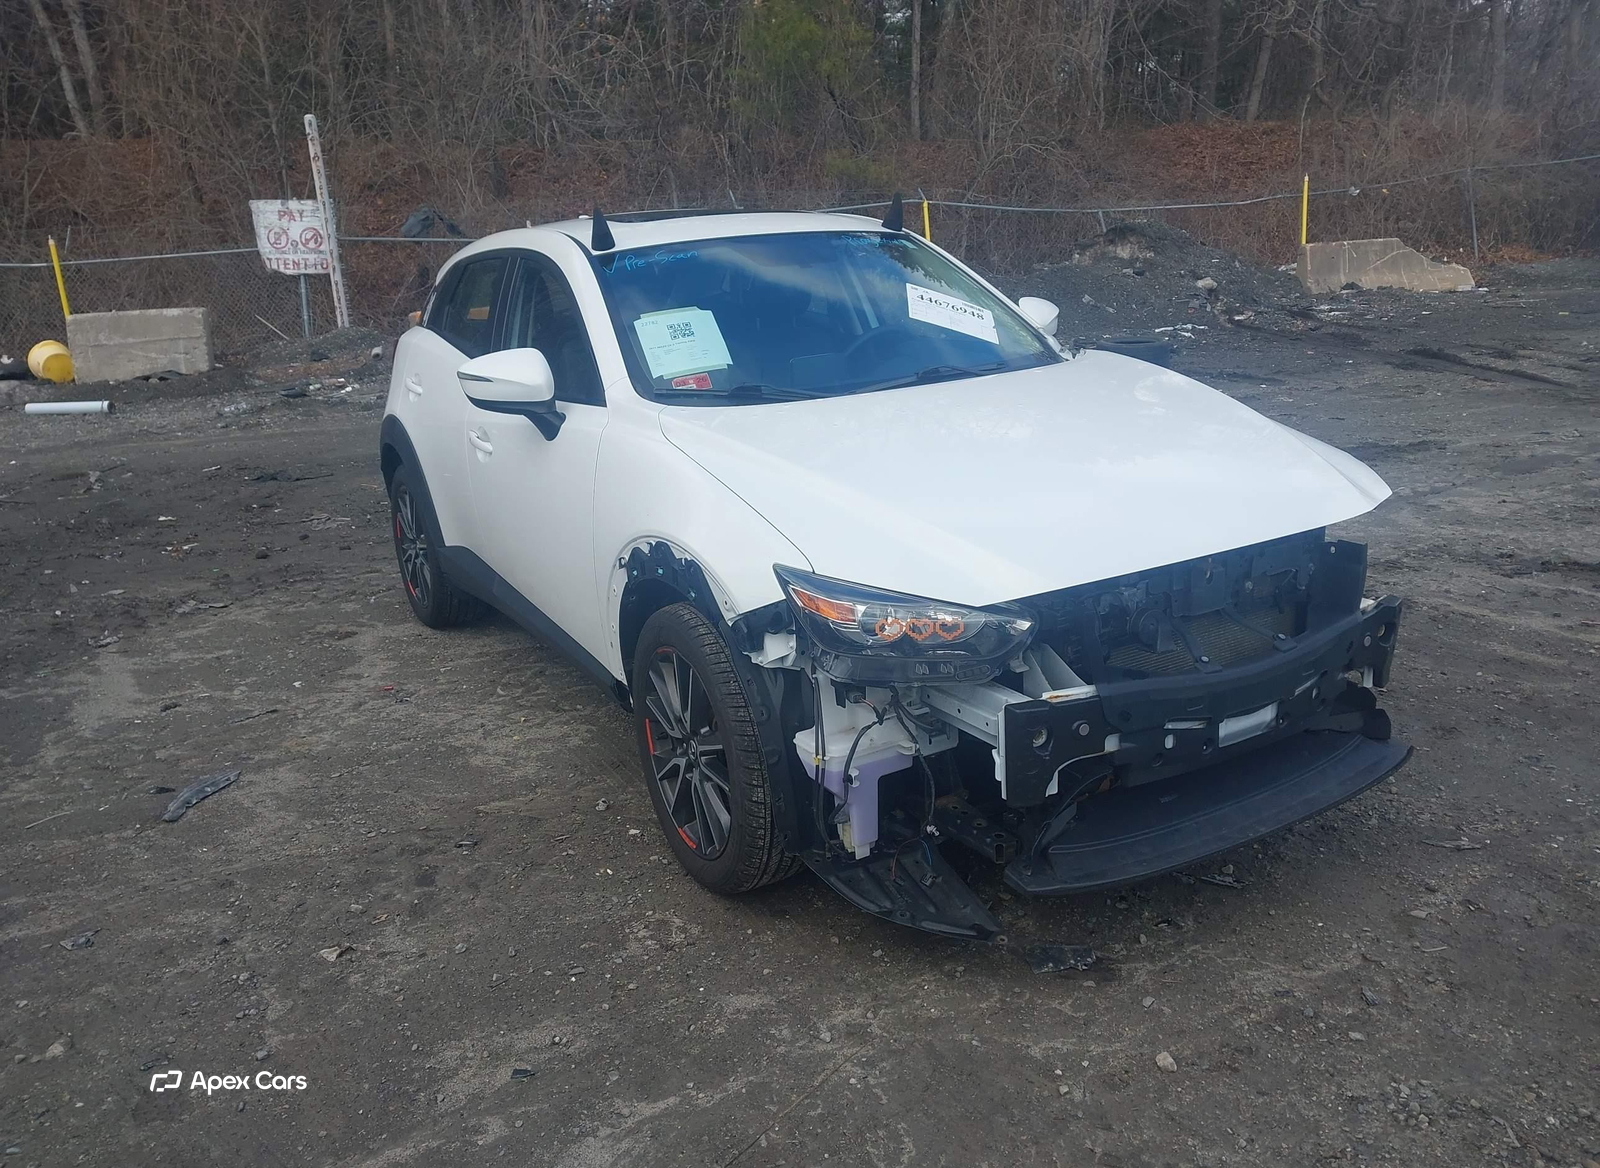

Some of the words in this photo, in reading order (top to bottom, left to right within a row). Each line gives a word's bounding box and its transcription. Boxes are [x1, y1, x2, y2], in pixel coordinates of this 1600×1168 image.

[278, 209, 304, 222] PAY
[624, 250, 699, 270] Pre-Scan
[916, 294, 985, 321] 44676948
